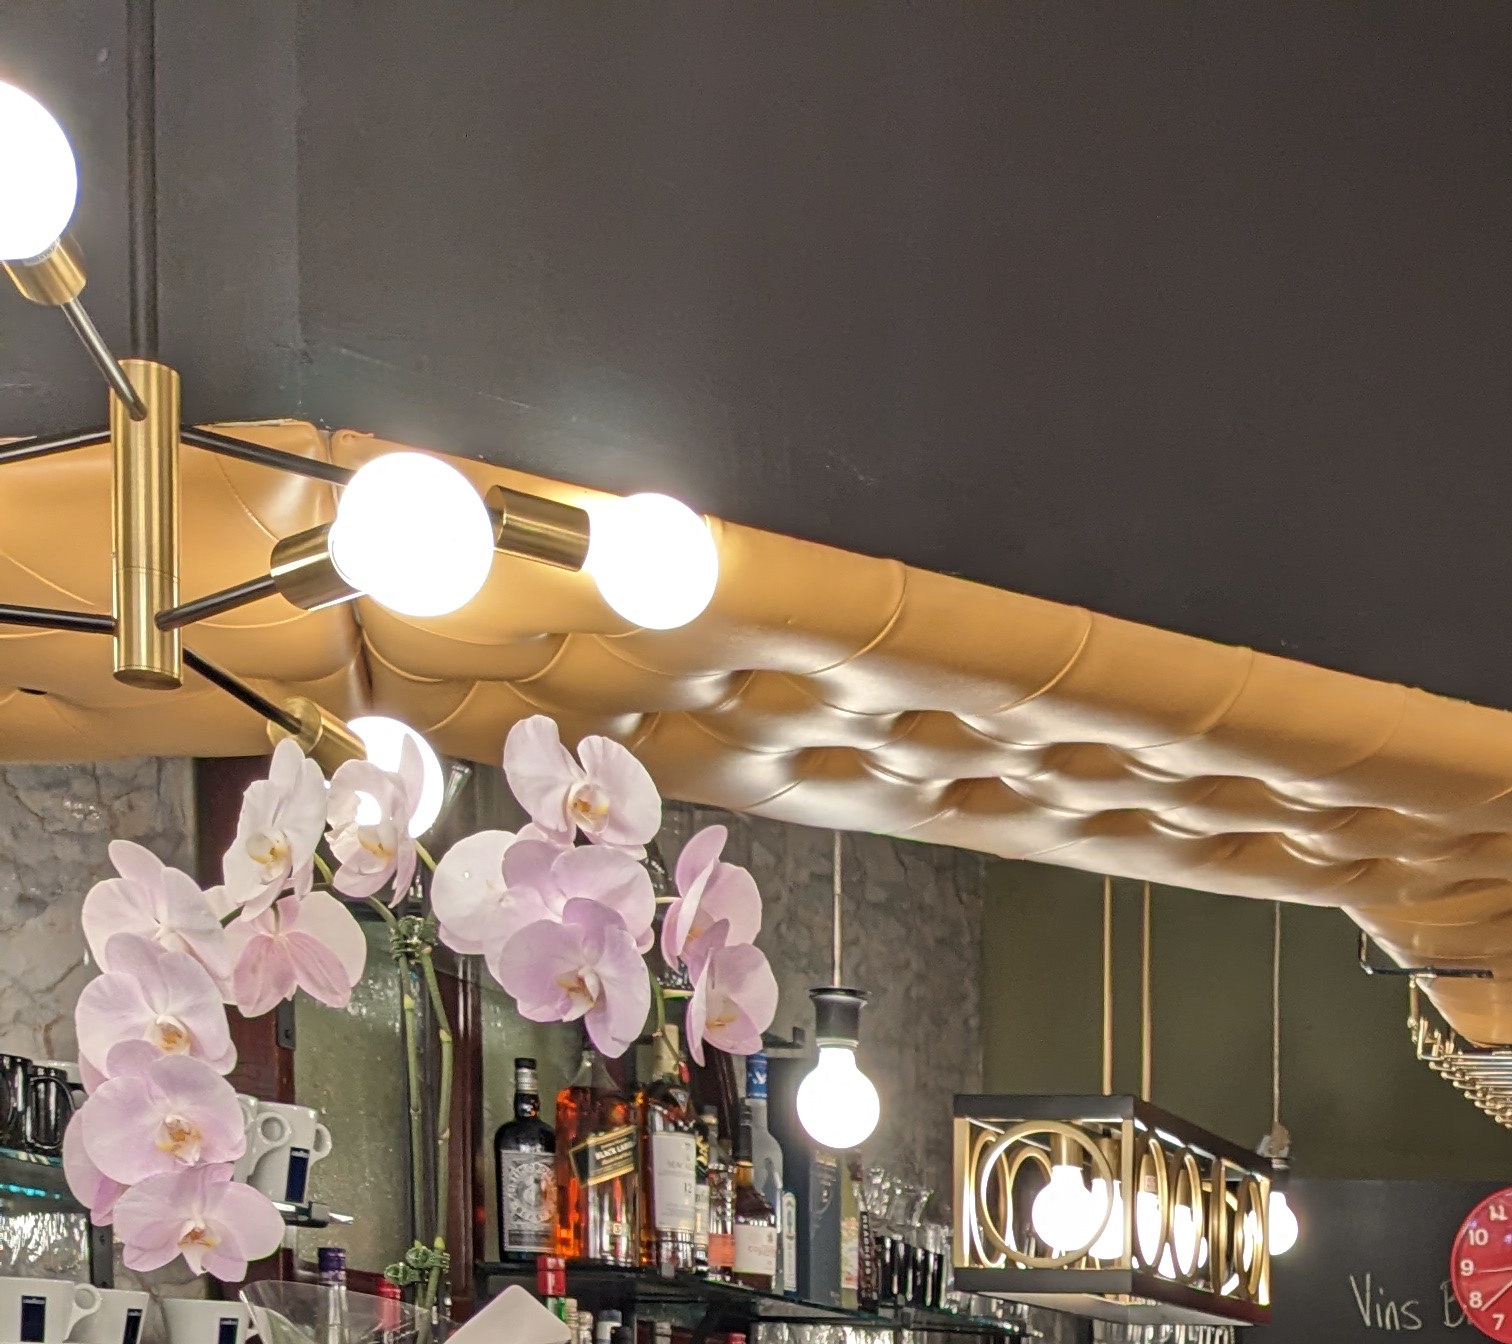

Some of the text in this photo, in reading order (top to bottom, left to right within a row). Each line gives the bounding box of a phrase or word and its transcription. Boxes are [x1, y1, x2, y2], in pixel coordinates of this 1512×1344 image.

[1468, 1228, 1489, 1246] 10
[1459, 1259, 1475, 1277] 9
[1348, 1273, 1424, 1332] Vins
[1468, 1290, 1483, 1309] 8
[1491, 1313, 1506, 1331] 7
